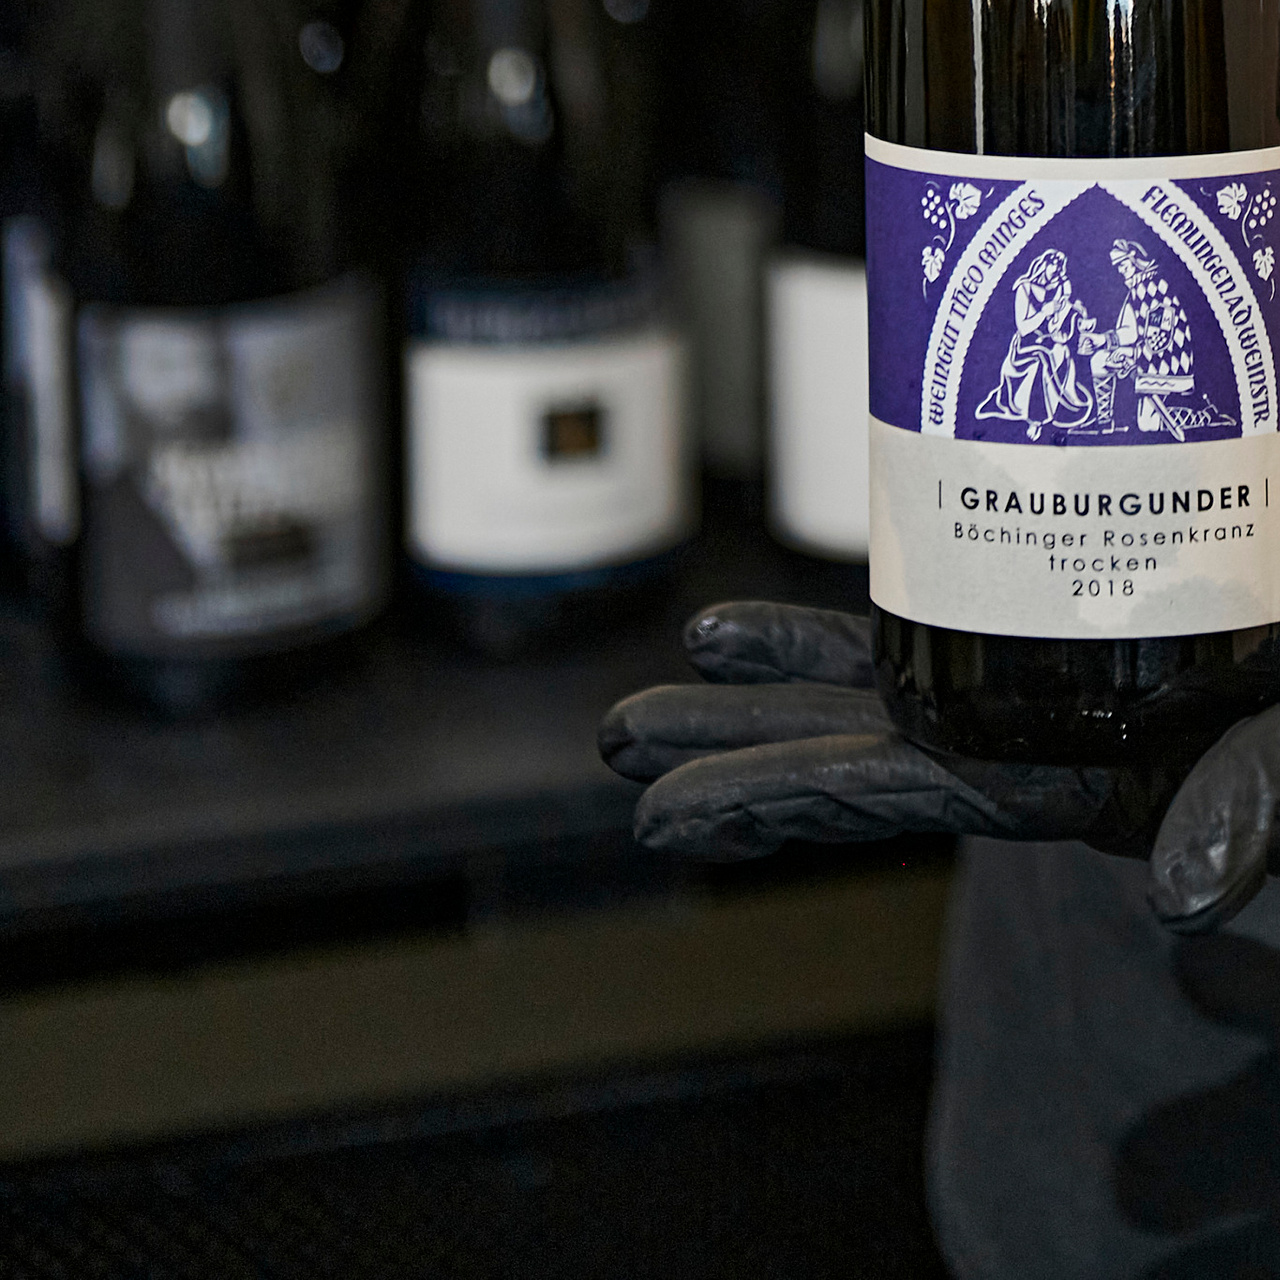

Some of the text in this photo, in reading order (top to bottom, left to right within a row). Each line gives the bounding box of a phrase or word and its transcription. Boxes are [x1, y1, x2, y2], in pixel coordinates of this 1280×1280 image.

[1140, 184, 1237, 300] FLEMLINGEN
[928, 319, 961, 427] WEINGUT
[978, 189, 1046, 270] MINGES
[960, 484, 1251, 517] GRAUBURGUNDER
[953, 521, 1256, 551] Böchinger Rosenkranz
[1048, 553, 1158, 572] trocken
[1070, 579, 1136, 598] 2018
